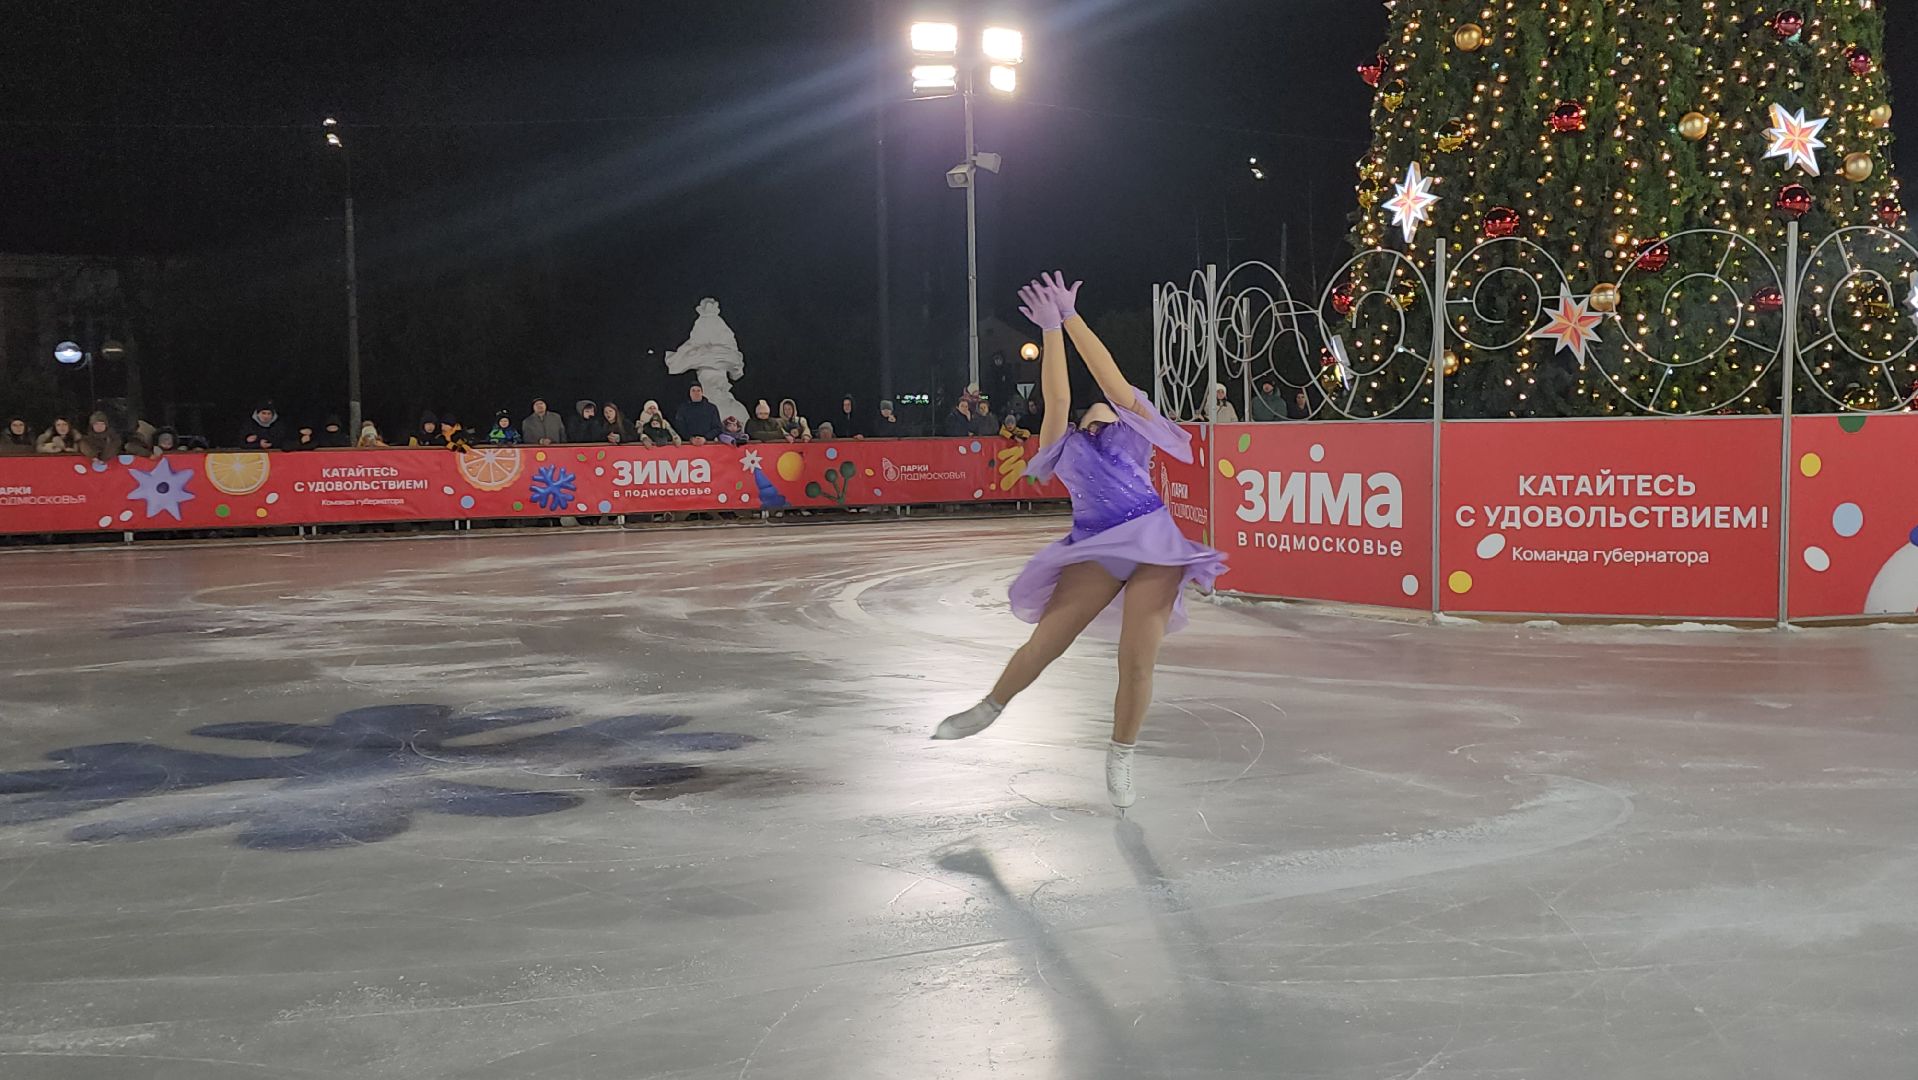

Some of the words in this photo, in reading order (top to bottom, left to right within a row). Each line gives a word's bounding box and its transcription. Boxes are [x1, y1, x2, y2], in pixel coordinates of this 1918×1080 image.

[322, 465, 398, 478] КАТАЙТЕСЬ
[900, 464, 929, 472] ПАРКИ
[294, 481, 305, 492] С
[308, 479, 428, 493] УДОВОЛЬСТВИЕМ!
[1519, 468, 1696, 497] КАТАЙТЕСЬ
[0, 486, 32, 495] АРКИ
[0, 494, 87, 505] ОДМОСКОВЬЯ
[1455, 505, 1476, 528] С
[1483, 505, 1769, 530] УДОВОЛЬСТВИЕМ!
[1512, 546, 1589, 564] Команда
[1593, 547, 1710, 567] губернатора
